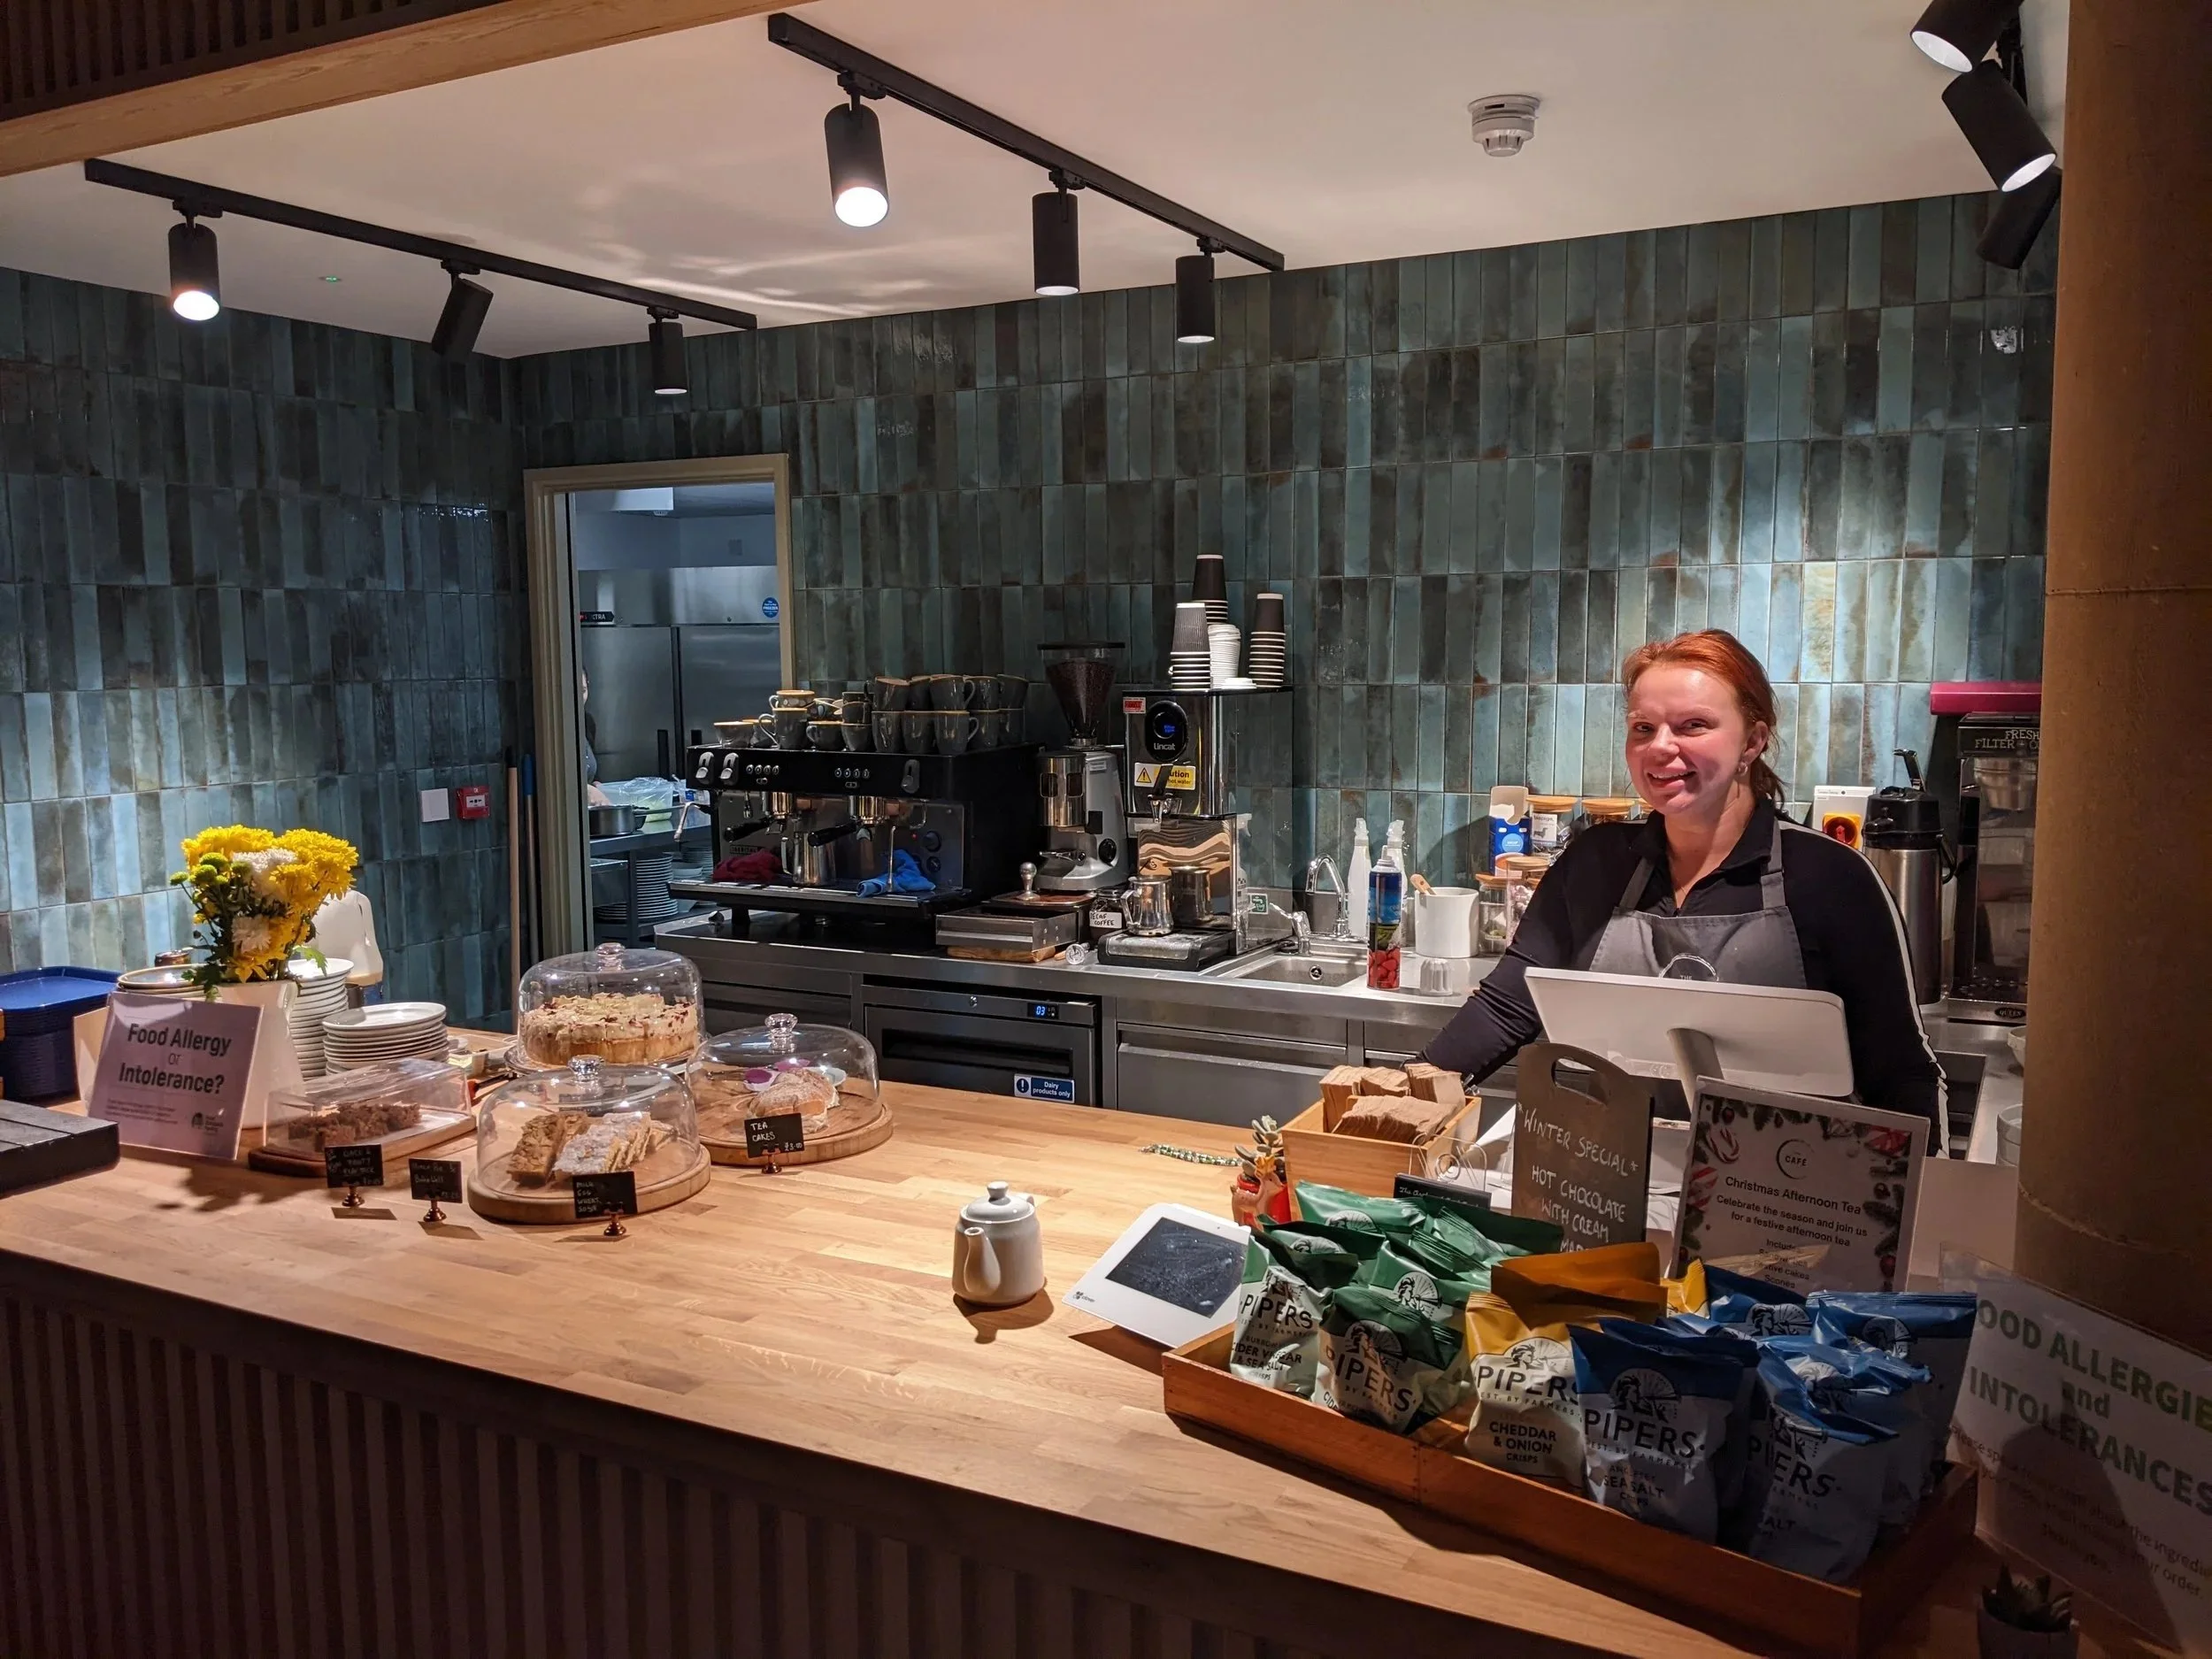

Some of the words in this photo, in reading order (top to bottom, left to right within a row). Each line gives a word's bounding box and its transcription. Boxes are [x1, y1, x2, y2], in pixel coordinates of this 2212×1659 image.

[1975, 738, 2016, 749] FILTER
[1169, 770, 1189, 779] ution
[1035, 1005, 1046, 1016] 03
[127, 1023, 169, 1046] Food
[170, 1028, 232, 1057] Allergy
[168, 1053, 180, 1065] or
[119, 1063, 225, 1094] Intolerance?
[1044, 1081, 1059, 1090] Dairy
[750, 1122, 768, 1131] TEA
[752, 1131, 775, 1141] CAKES
[1532, 1164, 1557, 1189] HOT
[1560, 1179, 1626, 1223] CHOCOLATE
[1725, 1176, 1779, 1197] Christmas
[1782, 1189, 1839, 1210] Afternoon
[1842, 1202, 1862, 1216] Tea
[1541, 1198, 1570, 1225] WITH
[1572, 1214, 1609, 1242] CREAM
[1717, 1194, 1761, 1213] Celebrate
[1763, 1204, 1778, 1216] the
[1780, 1210, 1814, 1225] season
[1816, 1217, 1834, 1230] and
[1835, 1221, 1853, 1233] join
[1855, 1227, 1868, 1237] us
[1731, 1210, 1744, 1221] for
[1754, 1216, 1785, 1232] festive
[1786, 1225, 1833, 1243] afternoon
[1835, 1236, 1851, 1248] tea
[1764, 1274, 1796, 1289] Scones
[1786, 1269, 1810, 1280] cakes
[1240, 1294, 1313, 1329] PIPERS
[1233, 1342, 1258, 1356] IDER
[1263, 1348, 1302, 1363] VIEGAR
[1246, 1357, 1263, 1368] SEA
[1977, 1299, 2042, 1350] OOD
[2049, 1331, 2212, 1433] ALLERGIE
[1325, 1345, 1414, 1412] PIPERS
[2062, 1380, 2110, 1419] and
[1489, 1421, 1557, 1442] CHEDDAR
[1585, 1409, 1697, 1458] PIPERS
[1970, 1366, 2212, 1517] INTOLERANCES
[1494, 1437, 1502, 1448] &
[1506, 1438, 1553, 1455] ONION
[1506, 1453, 1539, 1463] CRISPS
[1748, 1435, 1836, 1497] PIERS
[1632, 1482, 1664, 1499] SALT
[1764, 1517, 1796, 1531] ALT
